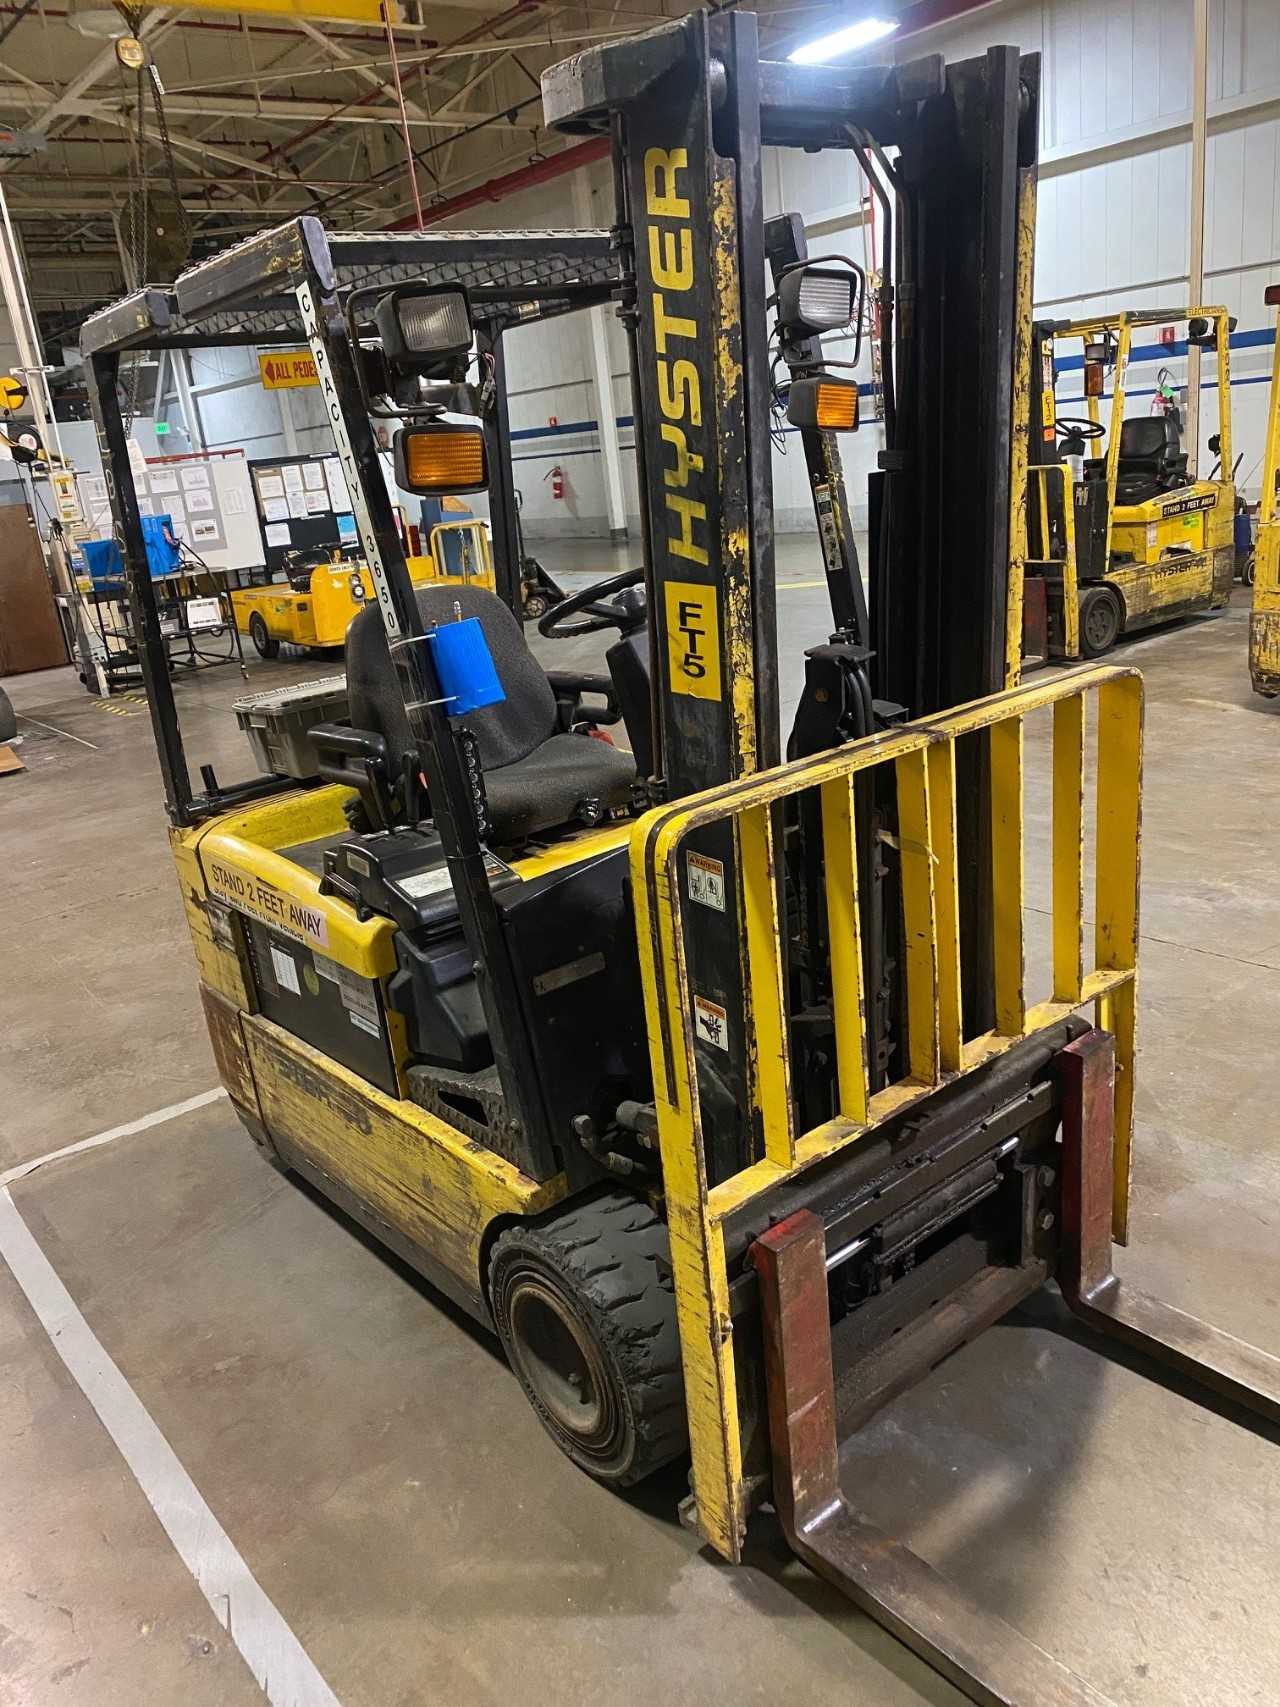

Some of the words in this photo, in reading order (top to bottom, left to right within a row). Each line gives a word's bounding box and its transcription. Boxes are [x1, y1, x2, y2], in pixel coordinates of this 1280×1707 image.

[275, 362, 292, 380] ALL
[645, 146, 708, 566] HYSTER
[301, 294, 360, 501] CAPACITY
[1186, 499, 1200, 510] FEET
[366, 535, 395, 629] 3650
[678, 601, 706, 679] FT5
[211, 863, 245, 896] STAND
[246, 881, 256, 903] 2
[256, 886, 285, 918] FEET
[289, 903, 321, 938] AWAY
